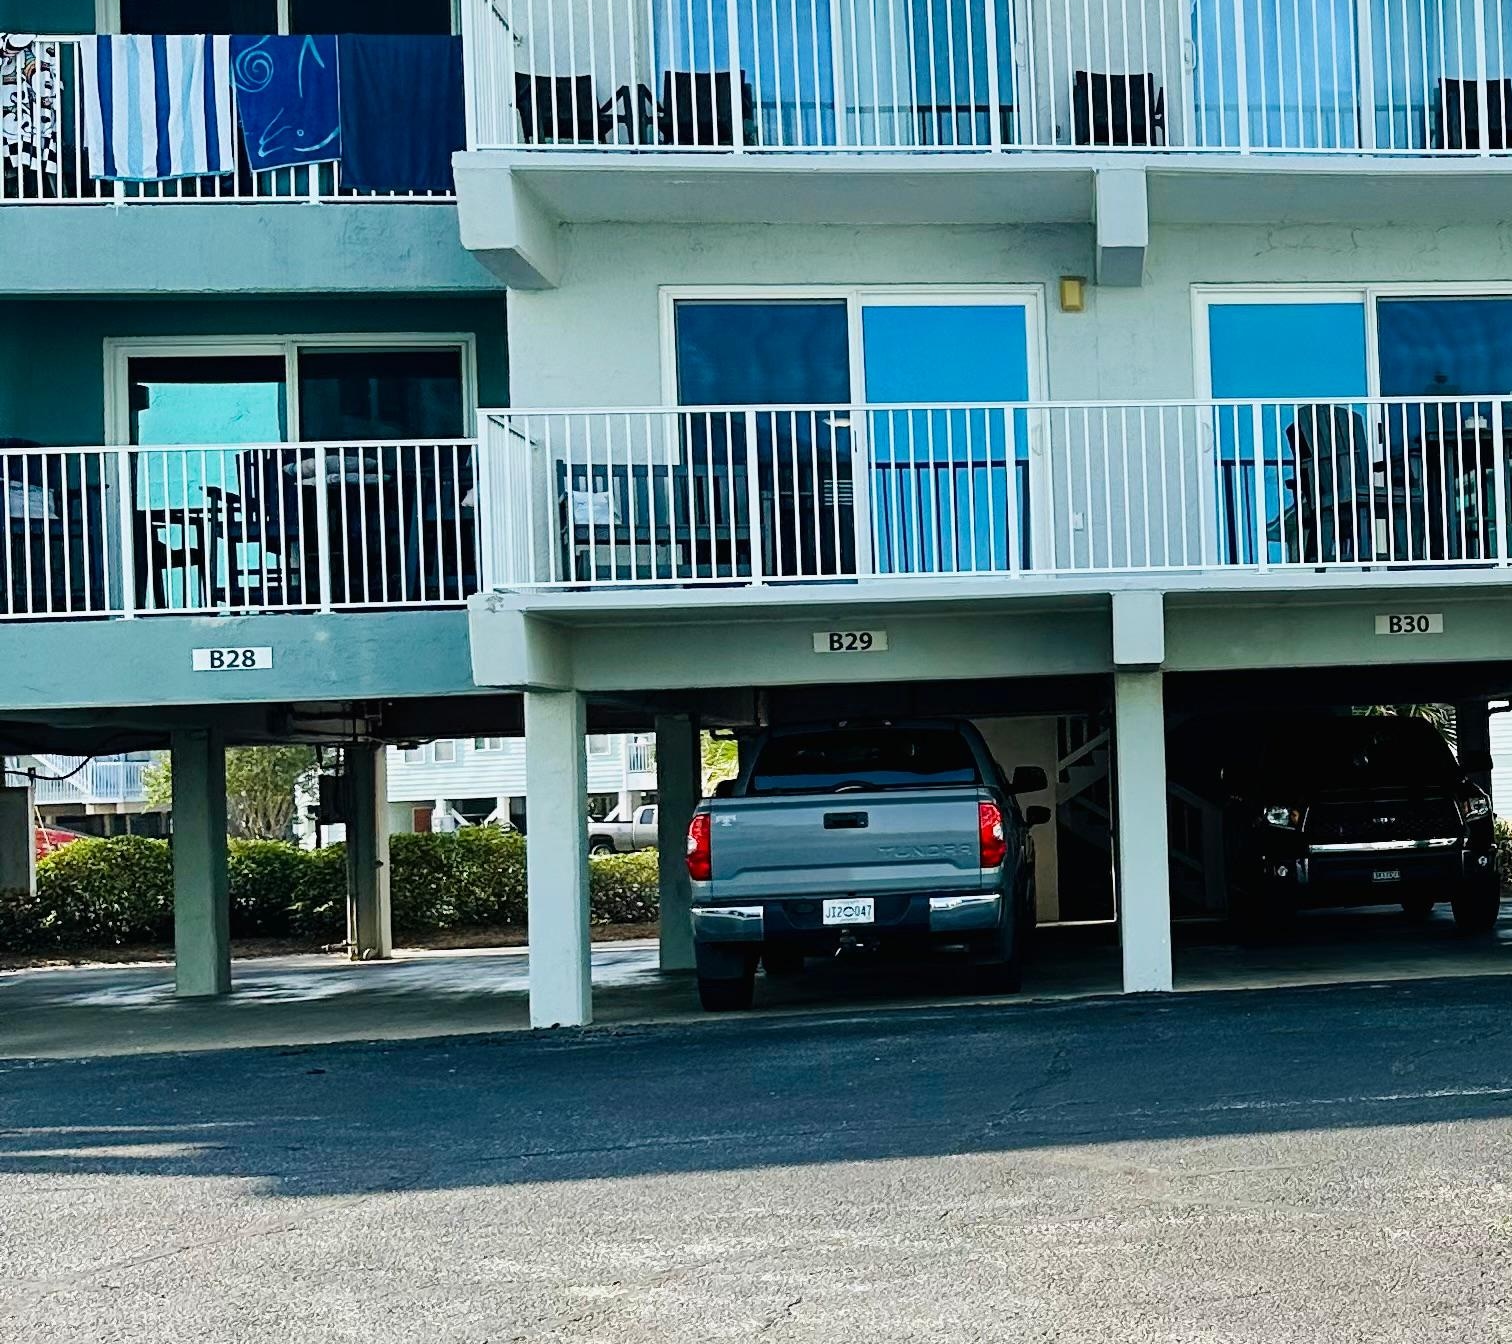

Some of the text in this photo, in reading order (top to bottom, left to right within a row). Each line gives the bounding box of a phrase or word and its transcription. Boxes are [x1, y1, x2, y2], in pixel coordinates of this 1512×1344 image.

[1389, 615, 1429, 633] B30
[829, 632, 873, 651] B29
[210, 650, 256, 668] B28
[878, 843, 973, 858] TUNDRA
